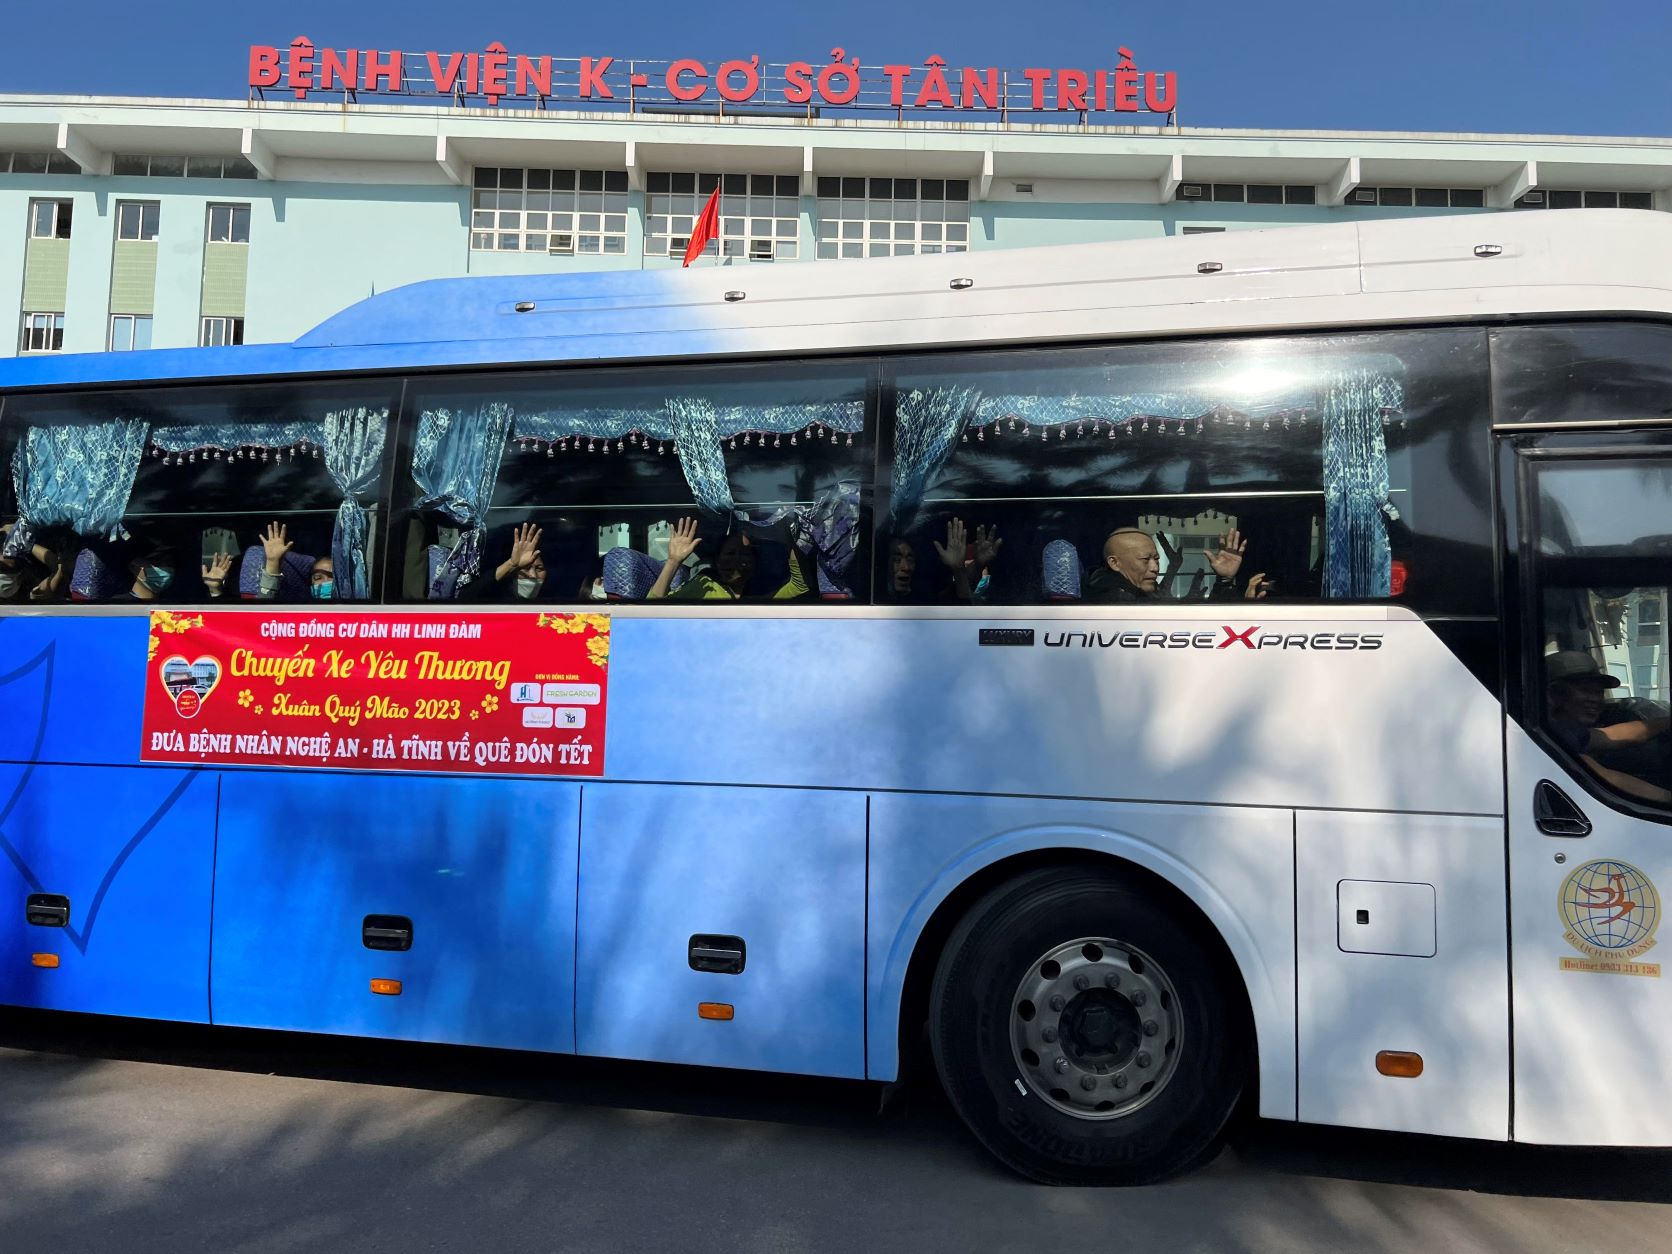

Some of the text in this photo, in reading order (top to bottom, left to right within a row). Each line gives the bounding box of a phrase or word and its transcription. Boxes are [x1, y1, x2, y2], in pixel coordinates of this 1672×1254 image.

[249, 36, 1177, 113] BỆNH VIỆN K - CƠ SỞ TÂN TRIỀU
[260, 618, 482, 641] CỘNG ĐỒNG CƯ DÂN HH LINH ĐÀM
[230, 644, 512, 690] Chuyến Xe Yêu Thương
[271, 693, 461, 727] Xuân Quý Mão 2023
[151, 729, 185, 752] ĐƯA
[189, 728, 232, 758] BỆNH
[235, 730, 282, 755] NHÂN
[285, 731, 331, 762] NGHỆ
[334, 738, 360, 758] AN
[372, 734, 397, 759] HÀ
[401, 734, 443, 761] TĨNH
[447, 732, 471, 762] VỀ
[474, 736, 511, 766] QUÊ
[515, 737, 554, 764] ĐÓN
[558, 735, 593, 765] TẾT
